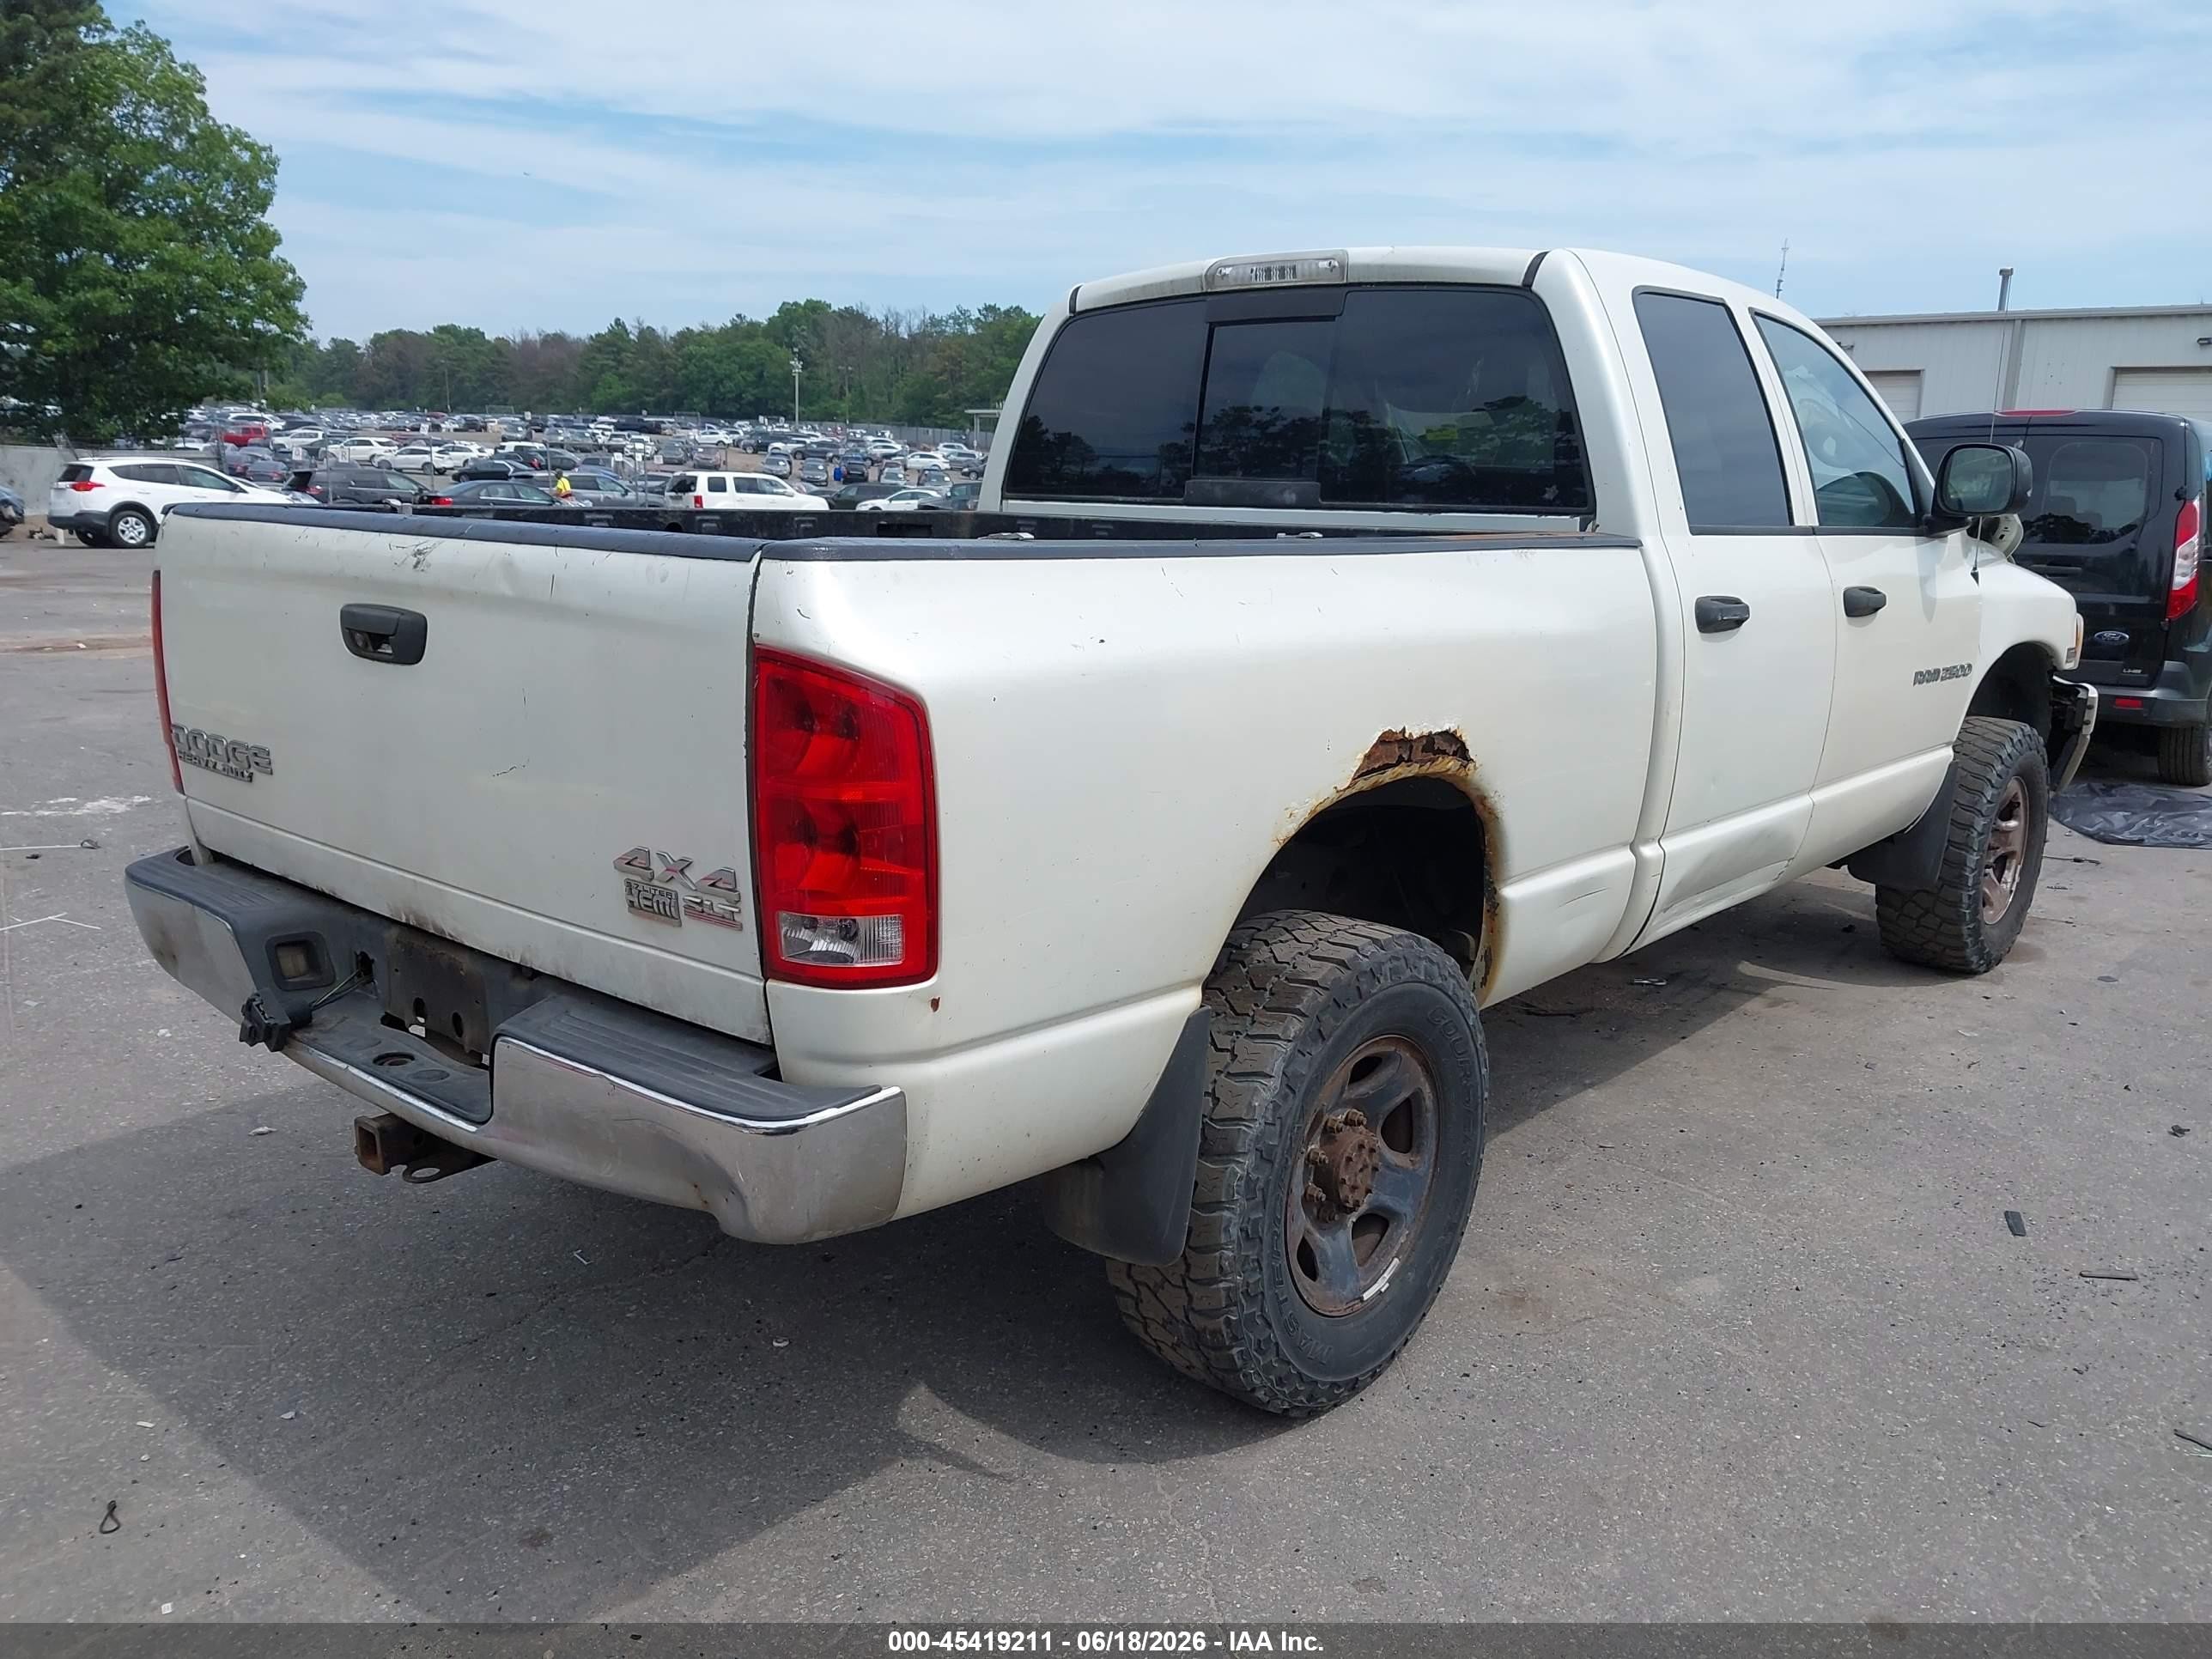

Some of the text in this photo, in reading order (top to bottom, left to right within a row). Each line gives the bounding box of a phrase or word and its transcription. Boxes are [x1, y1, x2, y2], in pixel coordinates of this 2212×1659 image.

[1913, 668, 1941, 687] RAM
[172, 723, 273, 776] DODGE
[641, 885, 673, 900] LITER
